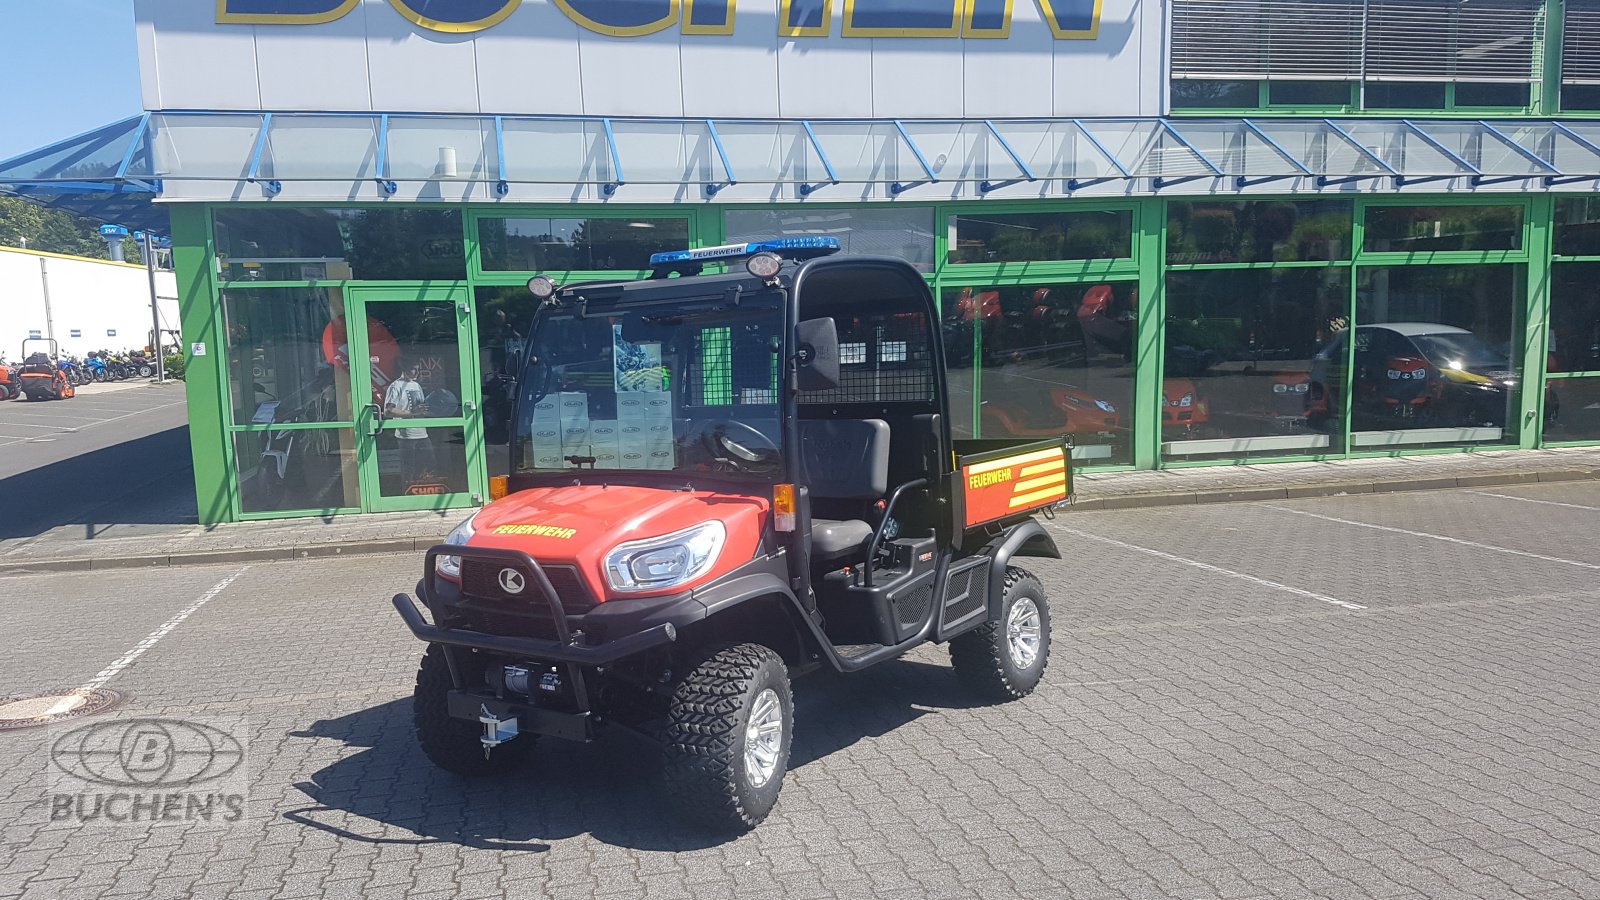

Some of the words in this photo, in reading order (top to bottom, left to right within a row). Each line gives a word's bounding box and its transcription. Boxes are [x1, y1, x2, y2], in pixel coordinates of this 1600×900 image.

[693, 247, 742, 258] FEUERWEHR
[969, 468, 1012, 489] FEUERWEHR
[492, 524, 577, 539] FEUERWEHR
